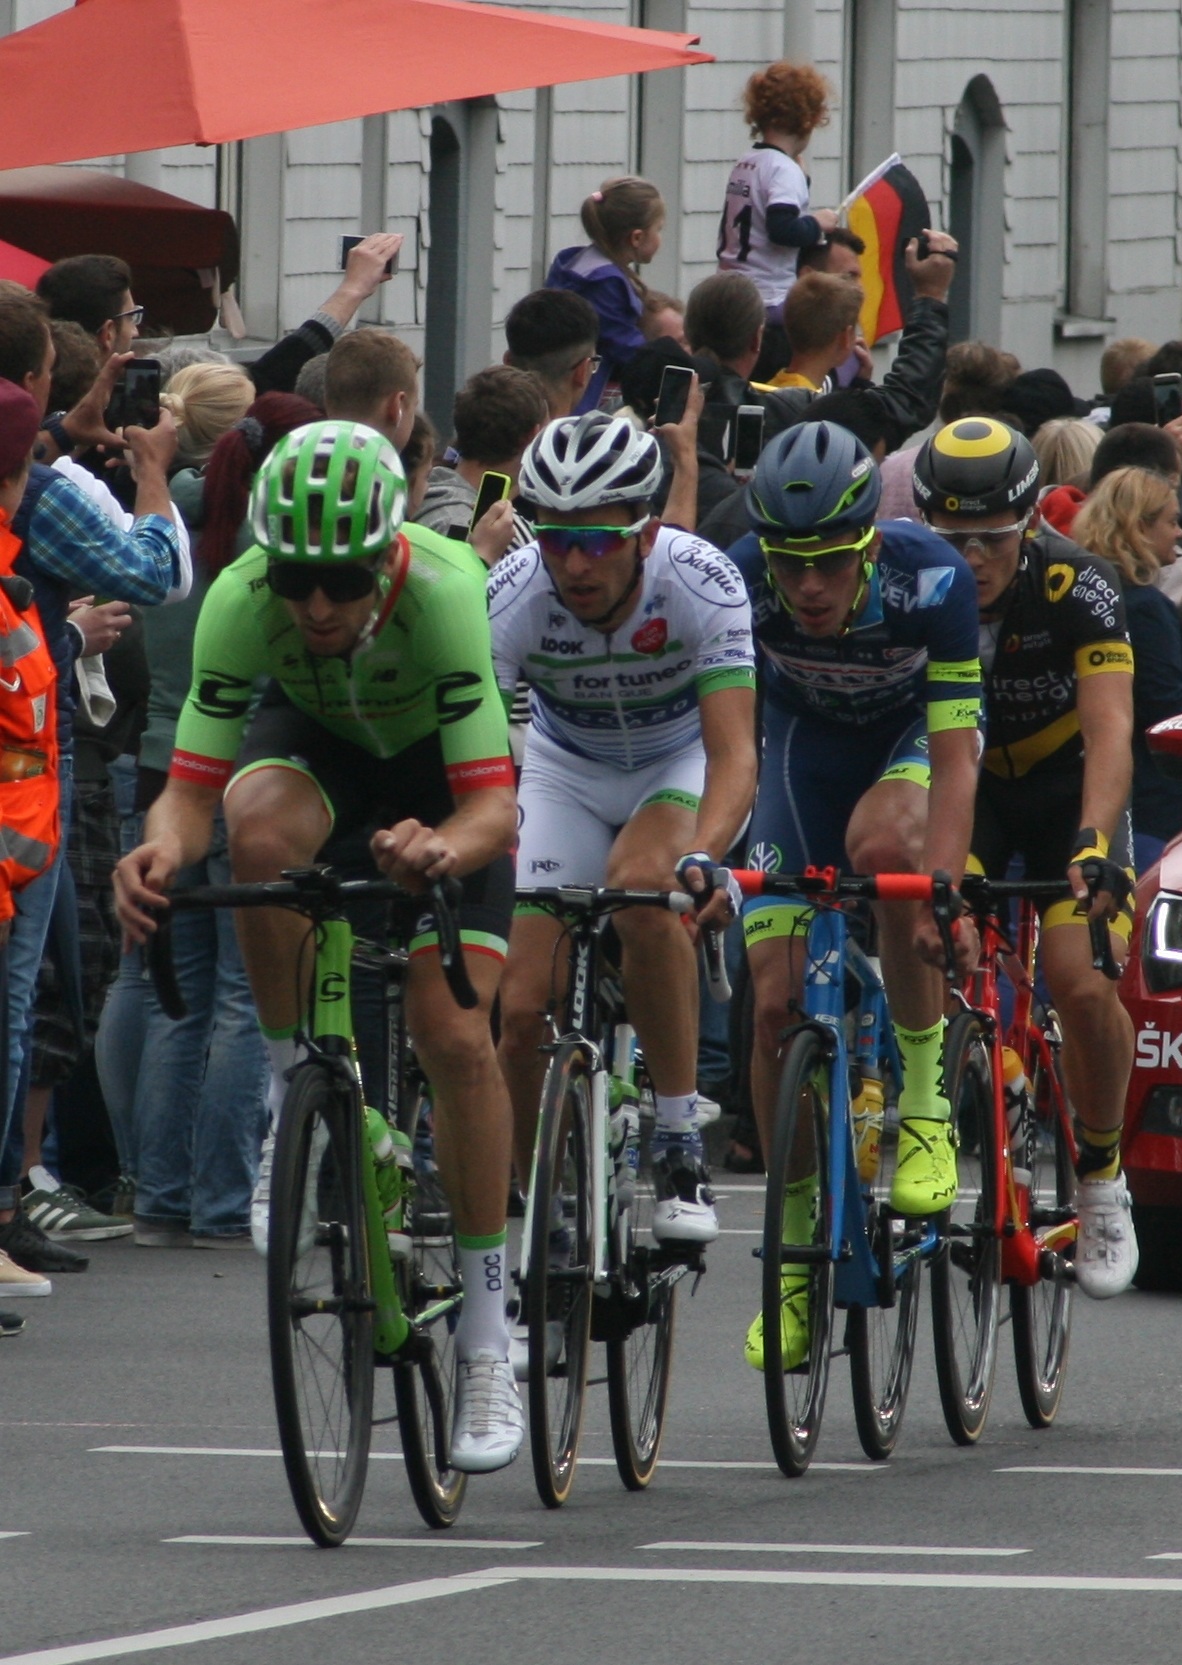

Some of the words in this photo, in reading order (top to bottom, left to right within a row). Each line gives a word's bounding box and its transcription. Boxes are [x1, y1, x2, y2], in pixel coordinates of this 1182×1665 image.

[486, 557, 529, 600] asque
[673, 545, 737, 596] Basque
[1078, 565, 1120, 606] direct
[541, 636, 585, 655] LOOK
[992, 669, 1062, 690] irect
[993, 673, 1077, 703] nergi
[572, 942, 589, 1030] LOOK
